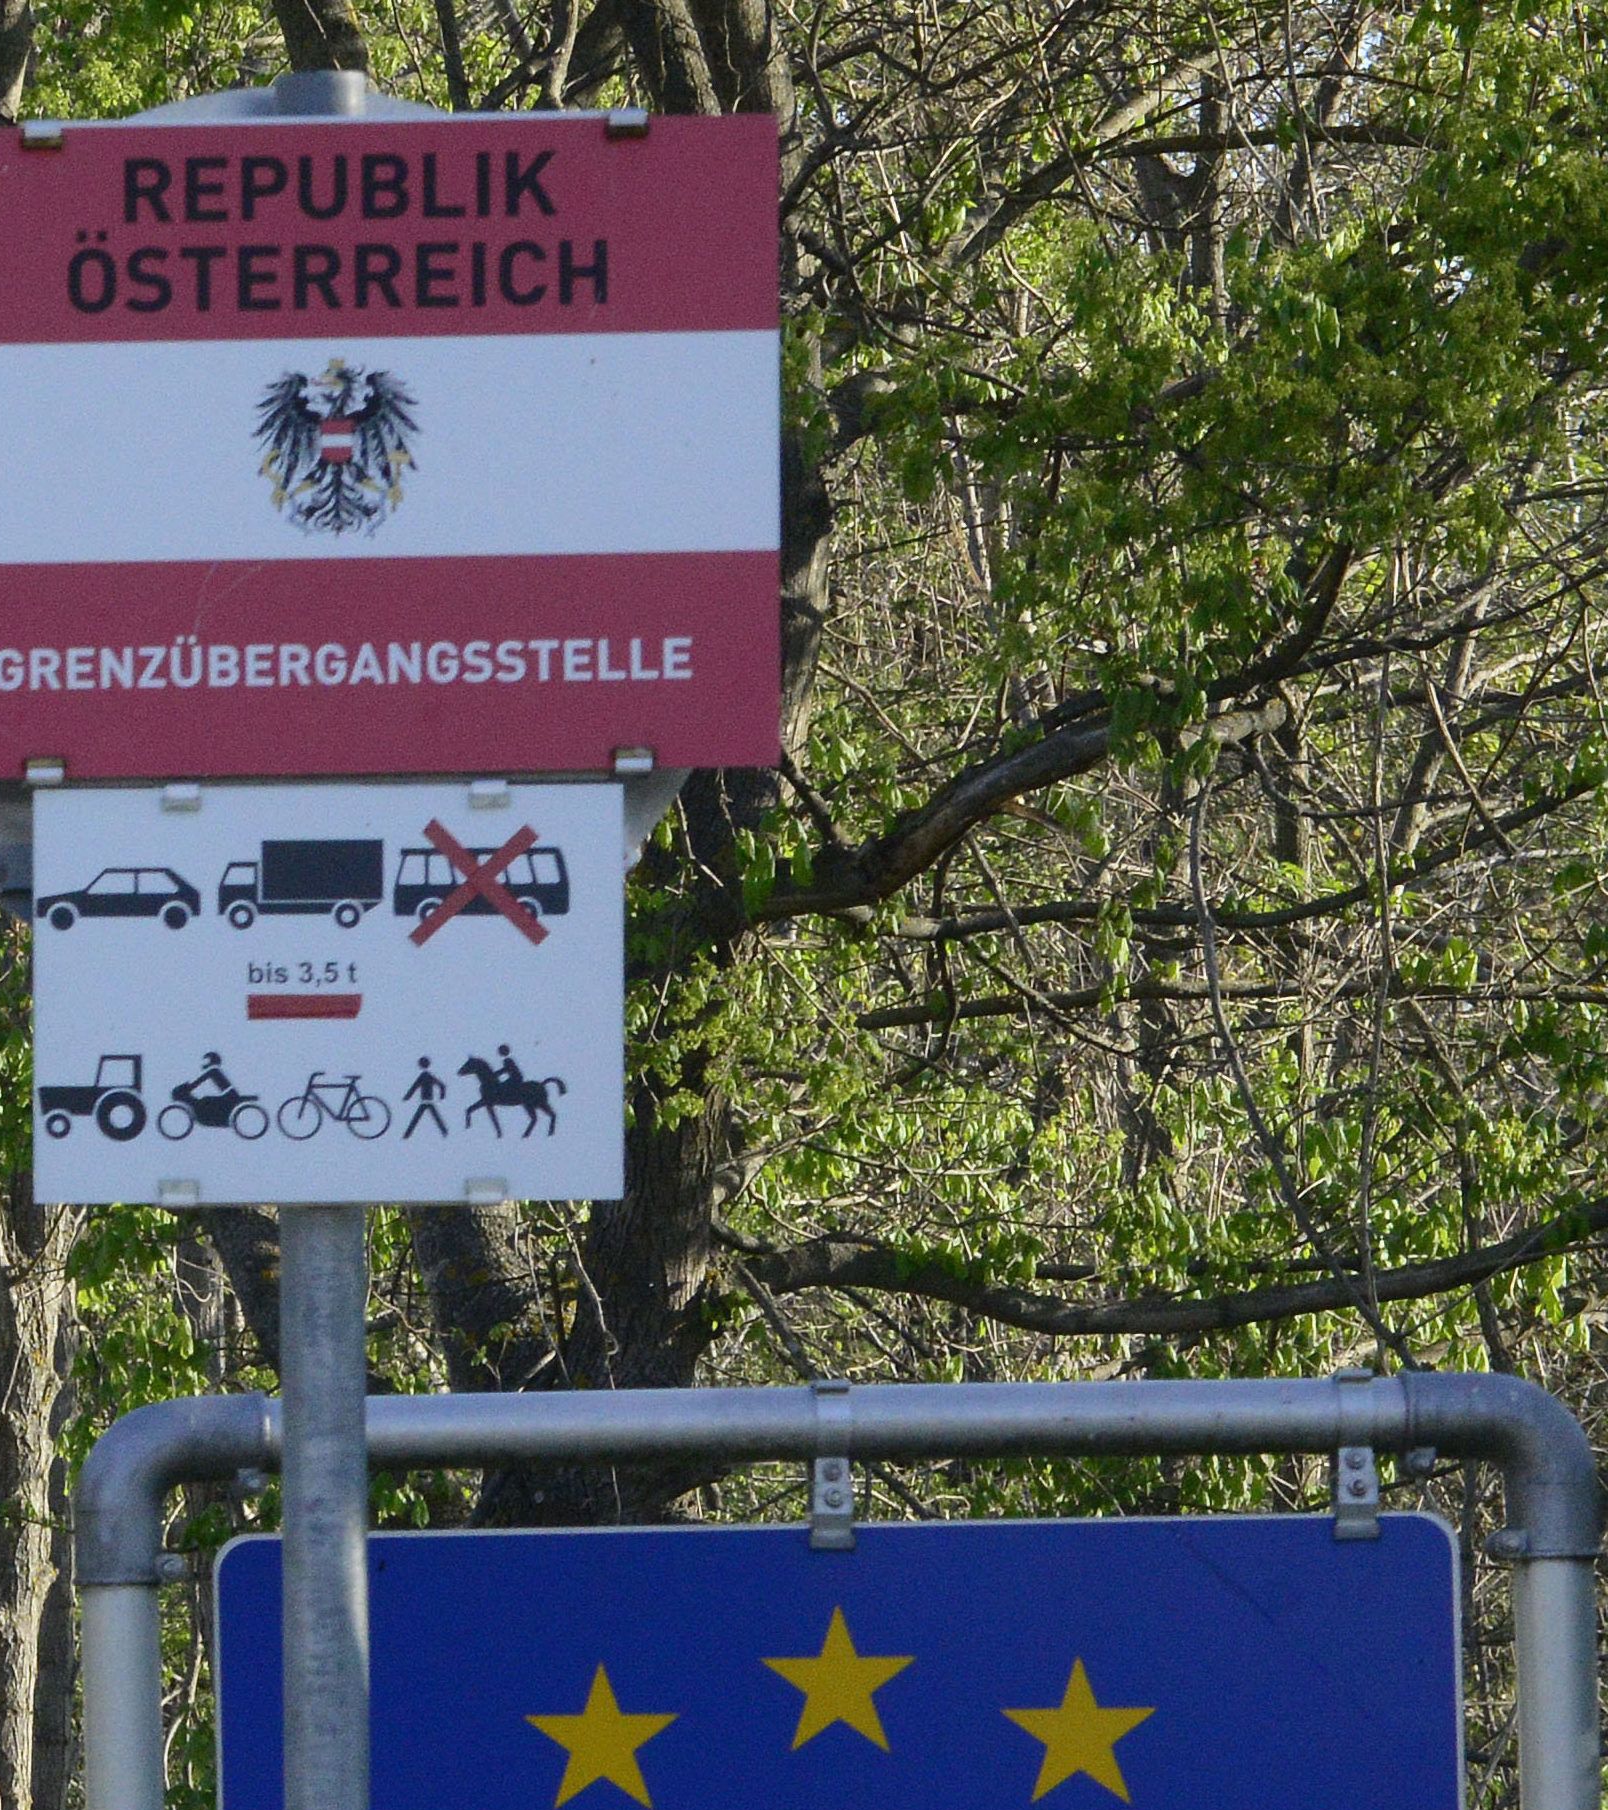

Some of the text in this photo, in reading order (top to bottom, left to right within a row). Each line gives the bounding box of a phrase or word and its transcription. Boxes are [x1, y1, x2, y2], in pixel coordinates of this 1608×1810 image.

[124, 151, 556, 223] REPUBLIK
[68, 231, 608, 314] ÖSTERREICH
[247, 961, 358, 987] bis 3,5 t
